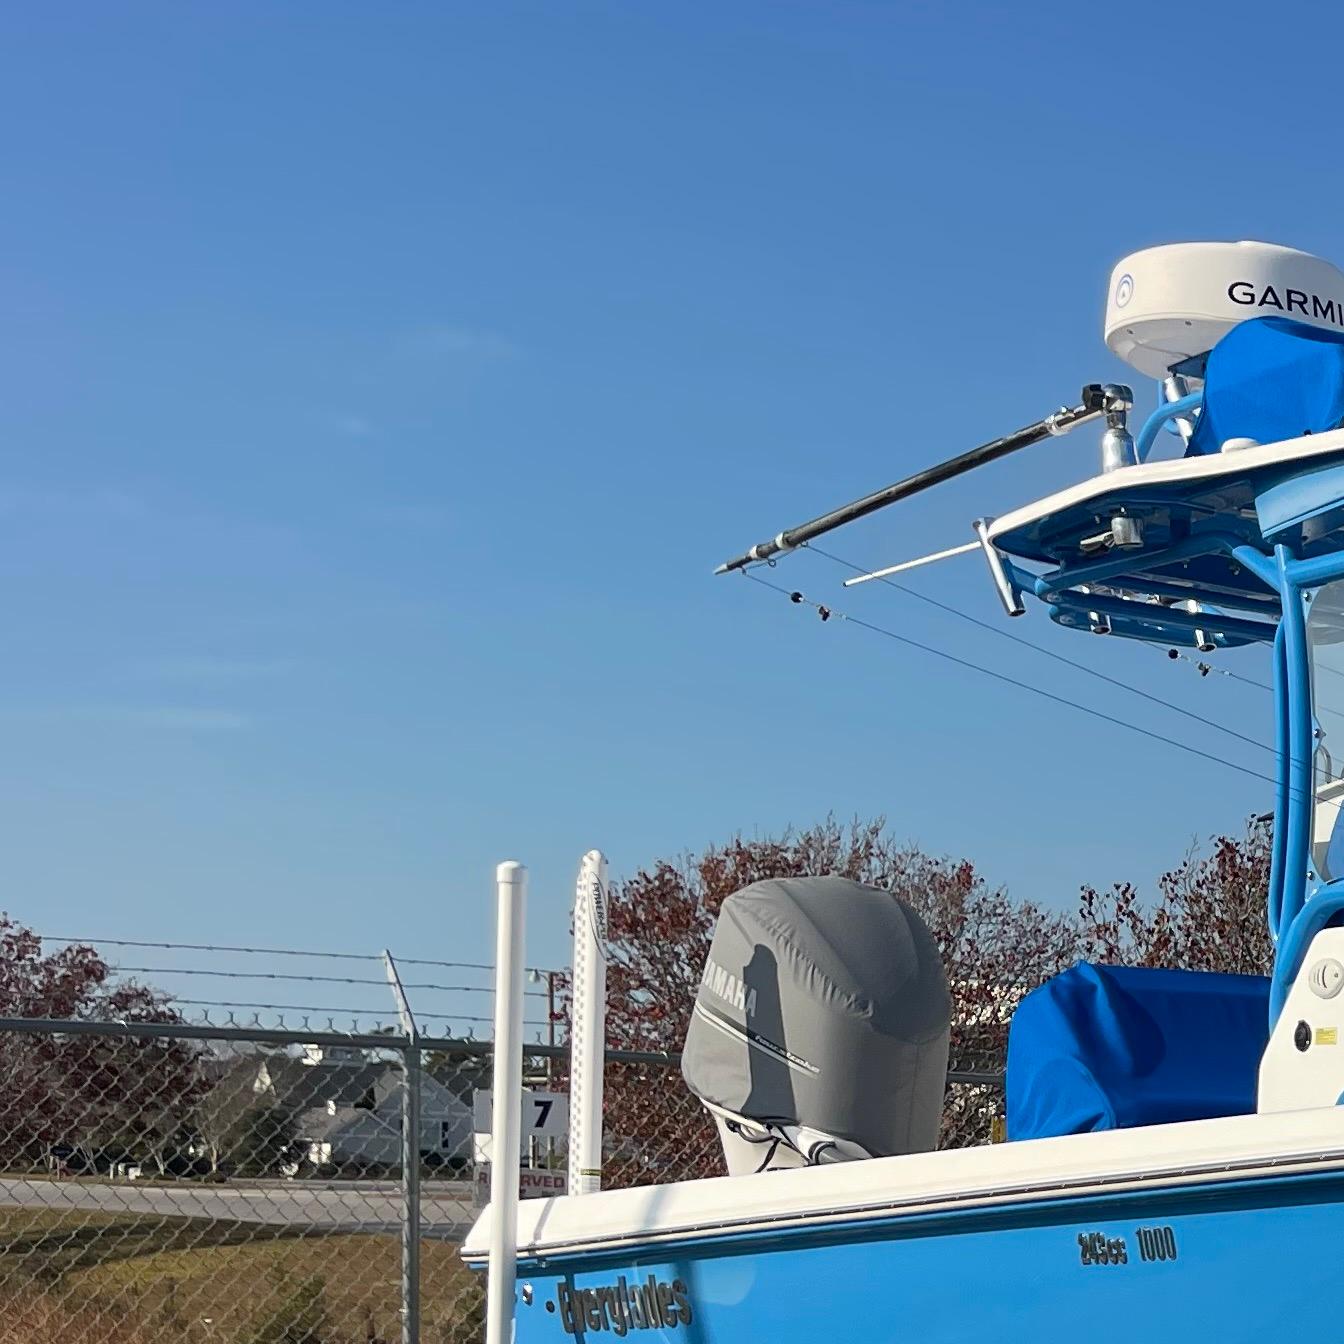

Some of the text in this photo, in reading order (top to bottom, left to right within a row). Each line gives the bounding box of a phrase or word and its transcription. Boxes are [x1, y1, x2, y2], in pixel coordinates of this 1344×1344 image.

[534, 1100, 553, 1129] 7
[478, 1171, 565, 1188] RRVED
[557, 1274, 693, 1337] Everglades
